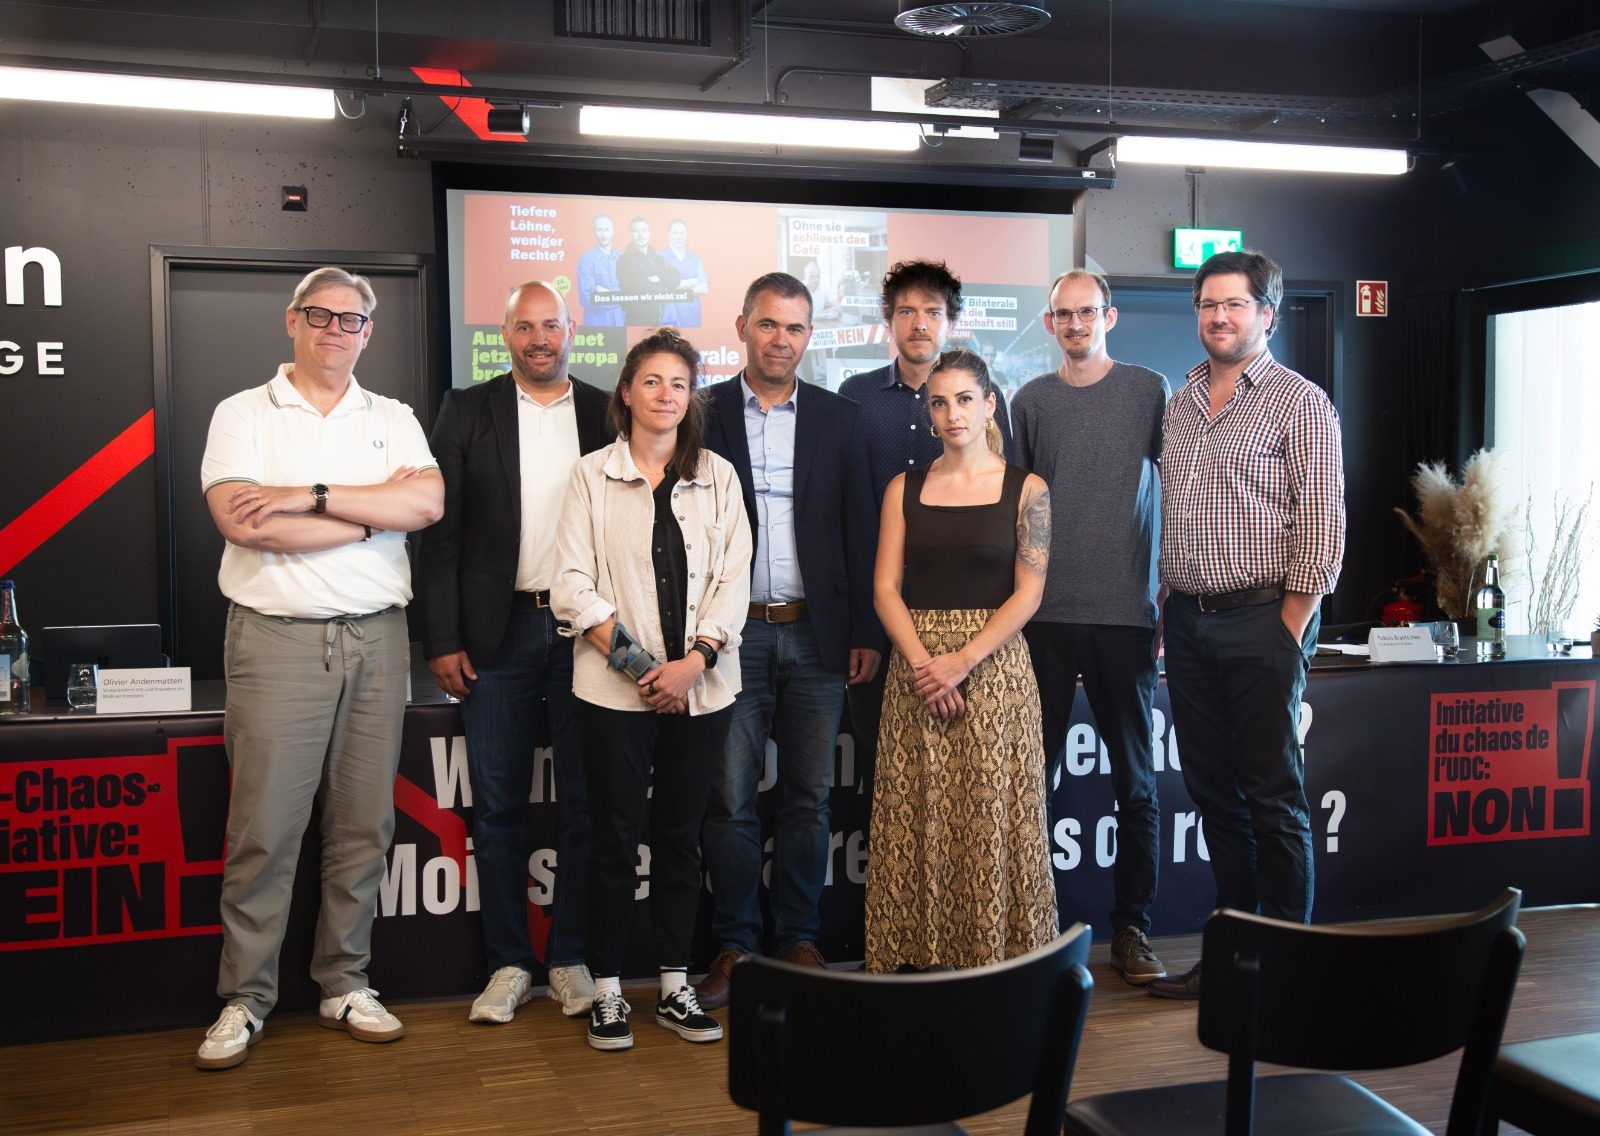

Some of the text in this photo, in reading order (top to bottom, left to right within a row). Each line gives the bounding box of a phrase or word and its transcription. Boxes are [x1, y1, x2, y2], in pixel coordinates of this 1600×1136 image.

[510, 205, 557, 217] Tiefere
[510, 219, 556, 234] Löhne,
[792, 220, 842, 232] Ohne sie
[510, 235, 564, 249] weniger
[792, 232, 866, 245] schliesst das
[510, 249, 565, 261] Rechte?
[792, 244, 820, 255] Café
[594, 292, 688, 303] Das lassen wir nicht zu!
[968, 298, 1015, 308] Bilaterale
[968, 308, 983, 317] die
[959, 319, 1014, 328] tschaft still
[836, 328, 865, 345] NEIN
[567, 351, 618, 367] uropa
[103, 678, 183, 686] Olivier Andenmatten
[1436, 698, 1525, 726] Initiative
[1435, 724, 1550, 754] du chaos de
[373, 837, 557, 918] Mois
